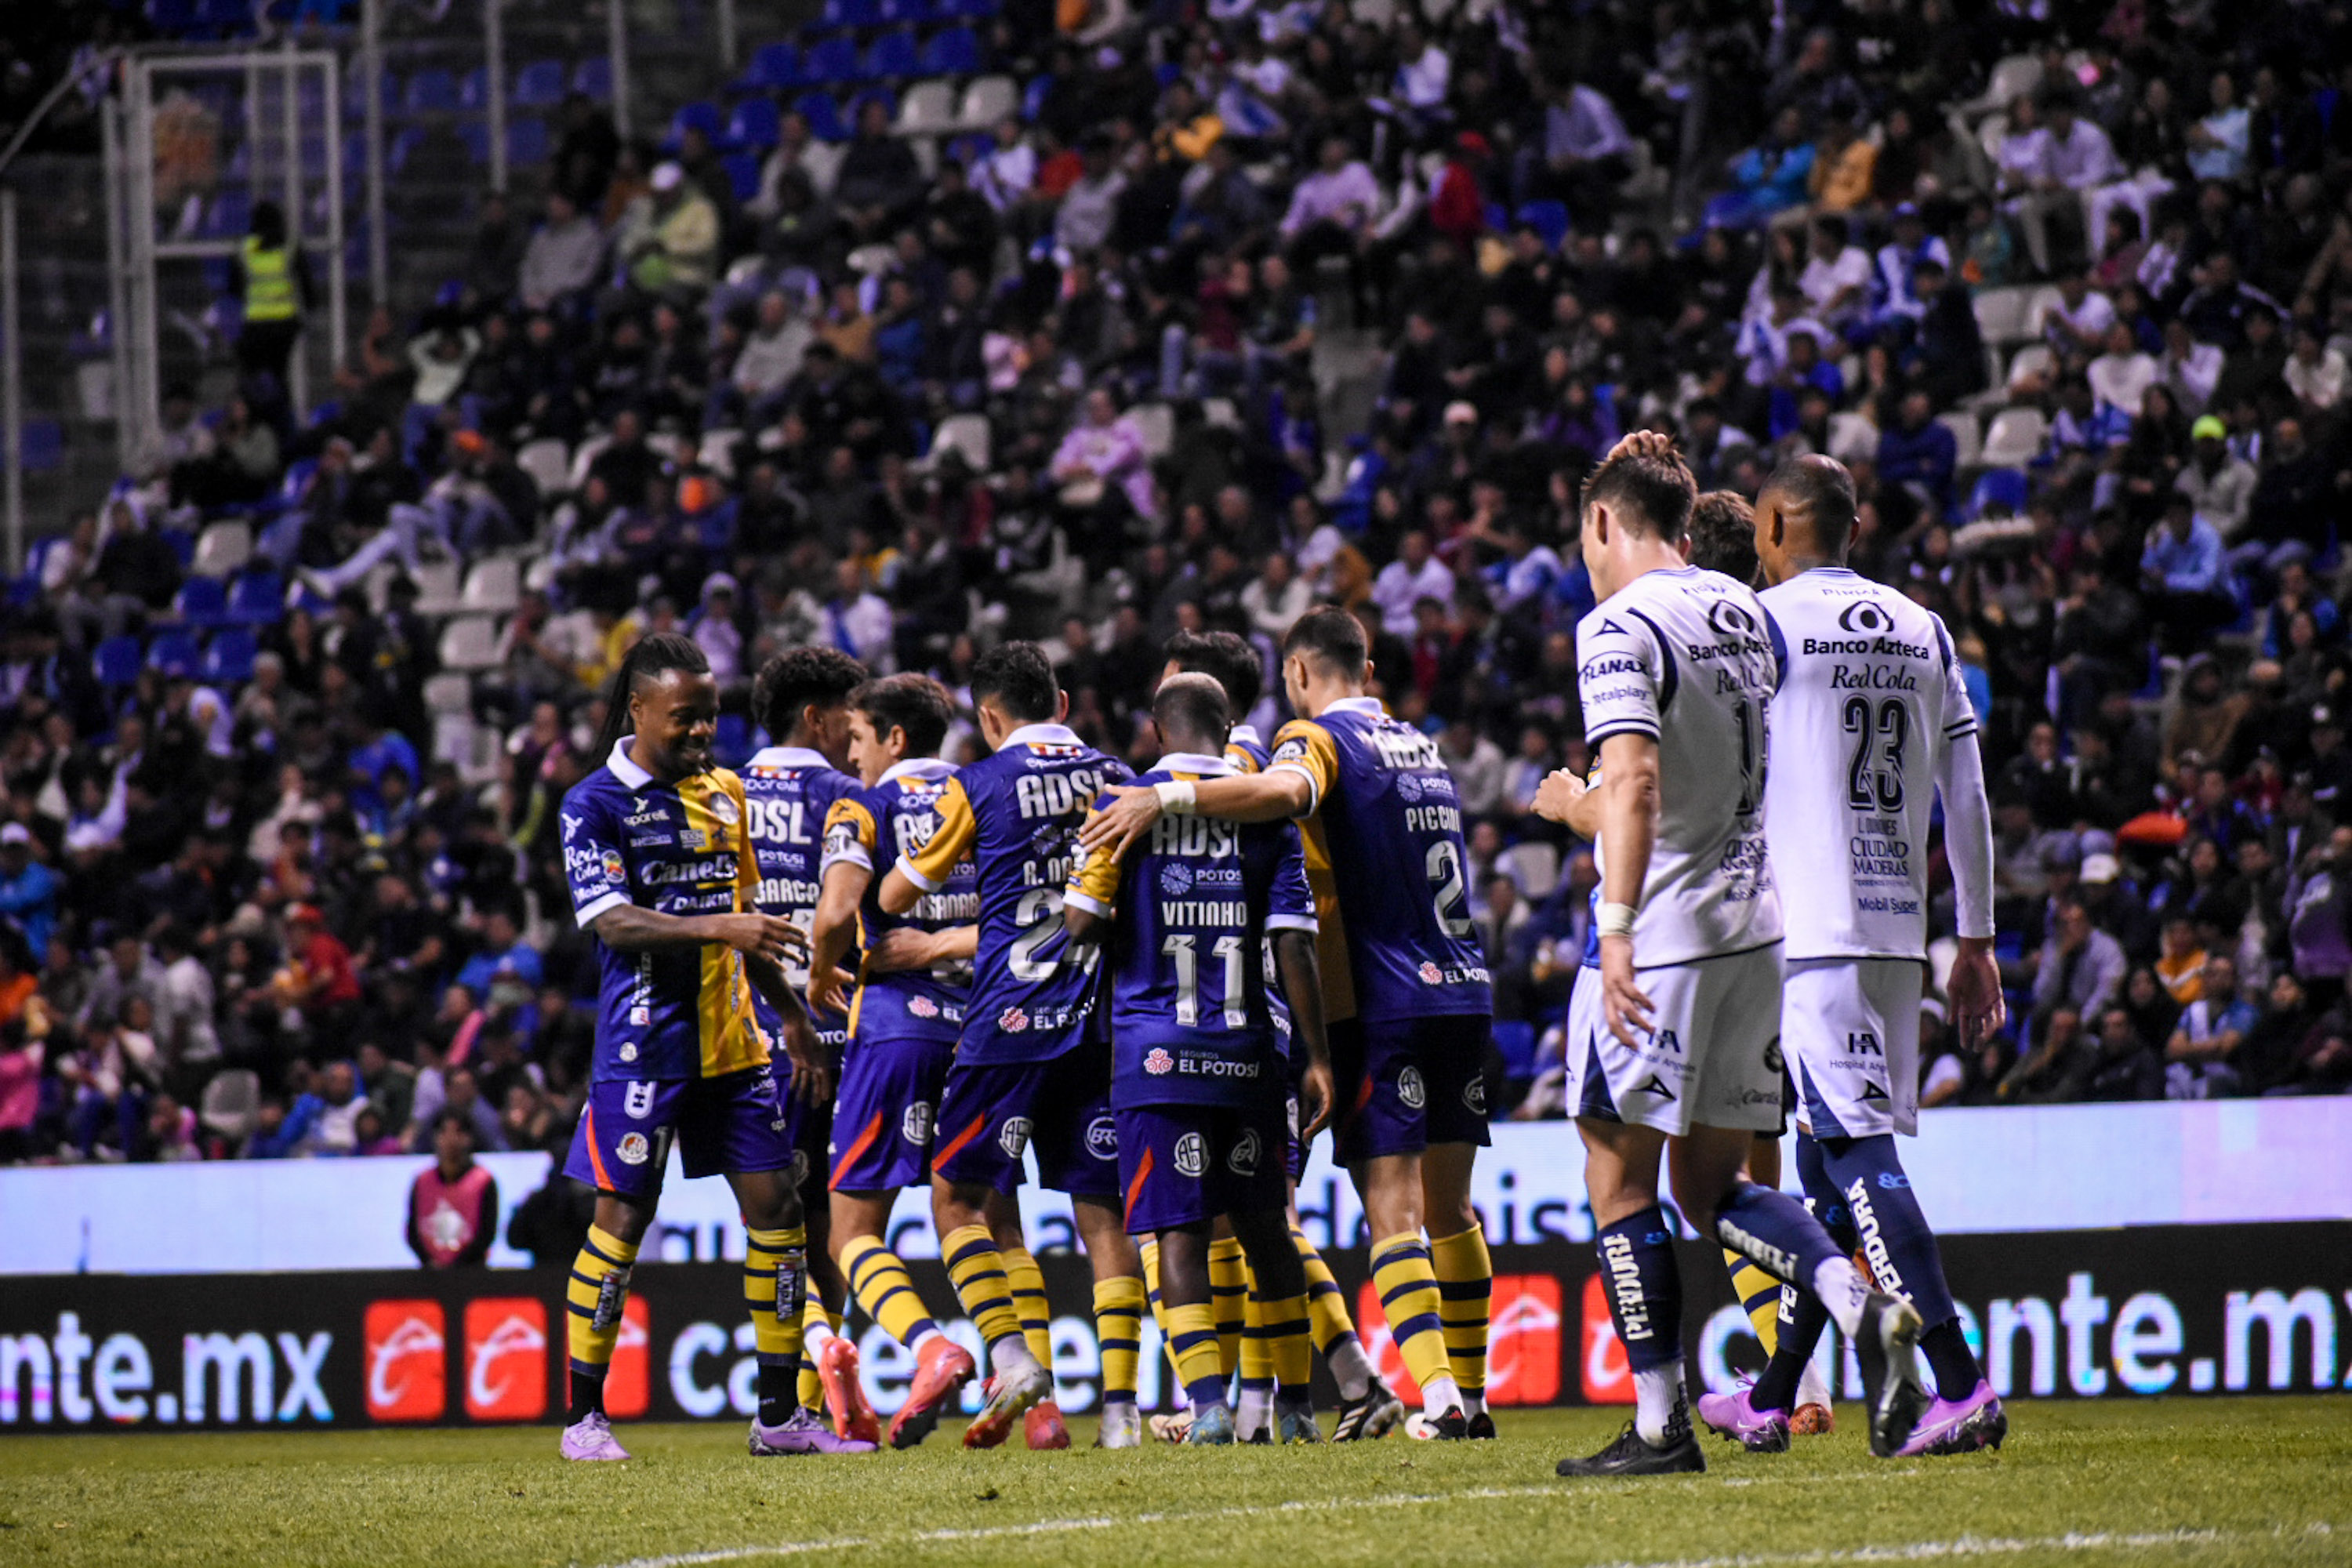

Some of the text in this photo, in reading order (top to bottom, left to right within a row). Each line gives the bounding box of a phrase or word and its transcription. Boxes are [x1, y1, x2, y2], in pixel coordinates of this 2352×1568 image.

[1689, 641, 1740, 662] Banco
[1803, 636, 1929, 659] Banco Azteca
[1843, 693, 1910, 813] 23
[1405, 805, 1461, 833] PICCIN
[564, 838, 601, 872] Red
[1850, 837, 1909, 858] CIUDAD
[575, 862, 601, 883] Cola
[1196, 869, 1243, 881] POTOS
[1853, 858, 1909, 876] MADERAS
[1425, 840, 1473, 938] 2
[1163, 901, 1248, 927] VITINHO
[1858, 897, 1918, 913] Mobil Super
[1162, 934, 1247, 1029] 11
[1445, 967, 1490, 984] EL POTO
[943, 1007, 962, 1022] EL
[1034, 1014, 1054, 1029] EL
[815, 1029, 848, 1045] OTO
[1179, 1049, 1219, 1059] SEGUROS
[1179, 1059, 1199, 1073] EL
[1829, 1059, 1866, 1071] Hospital
